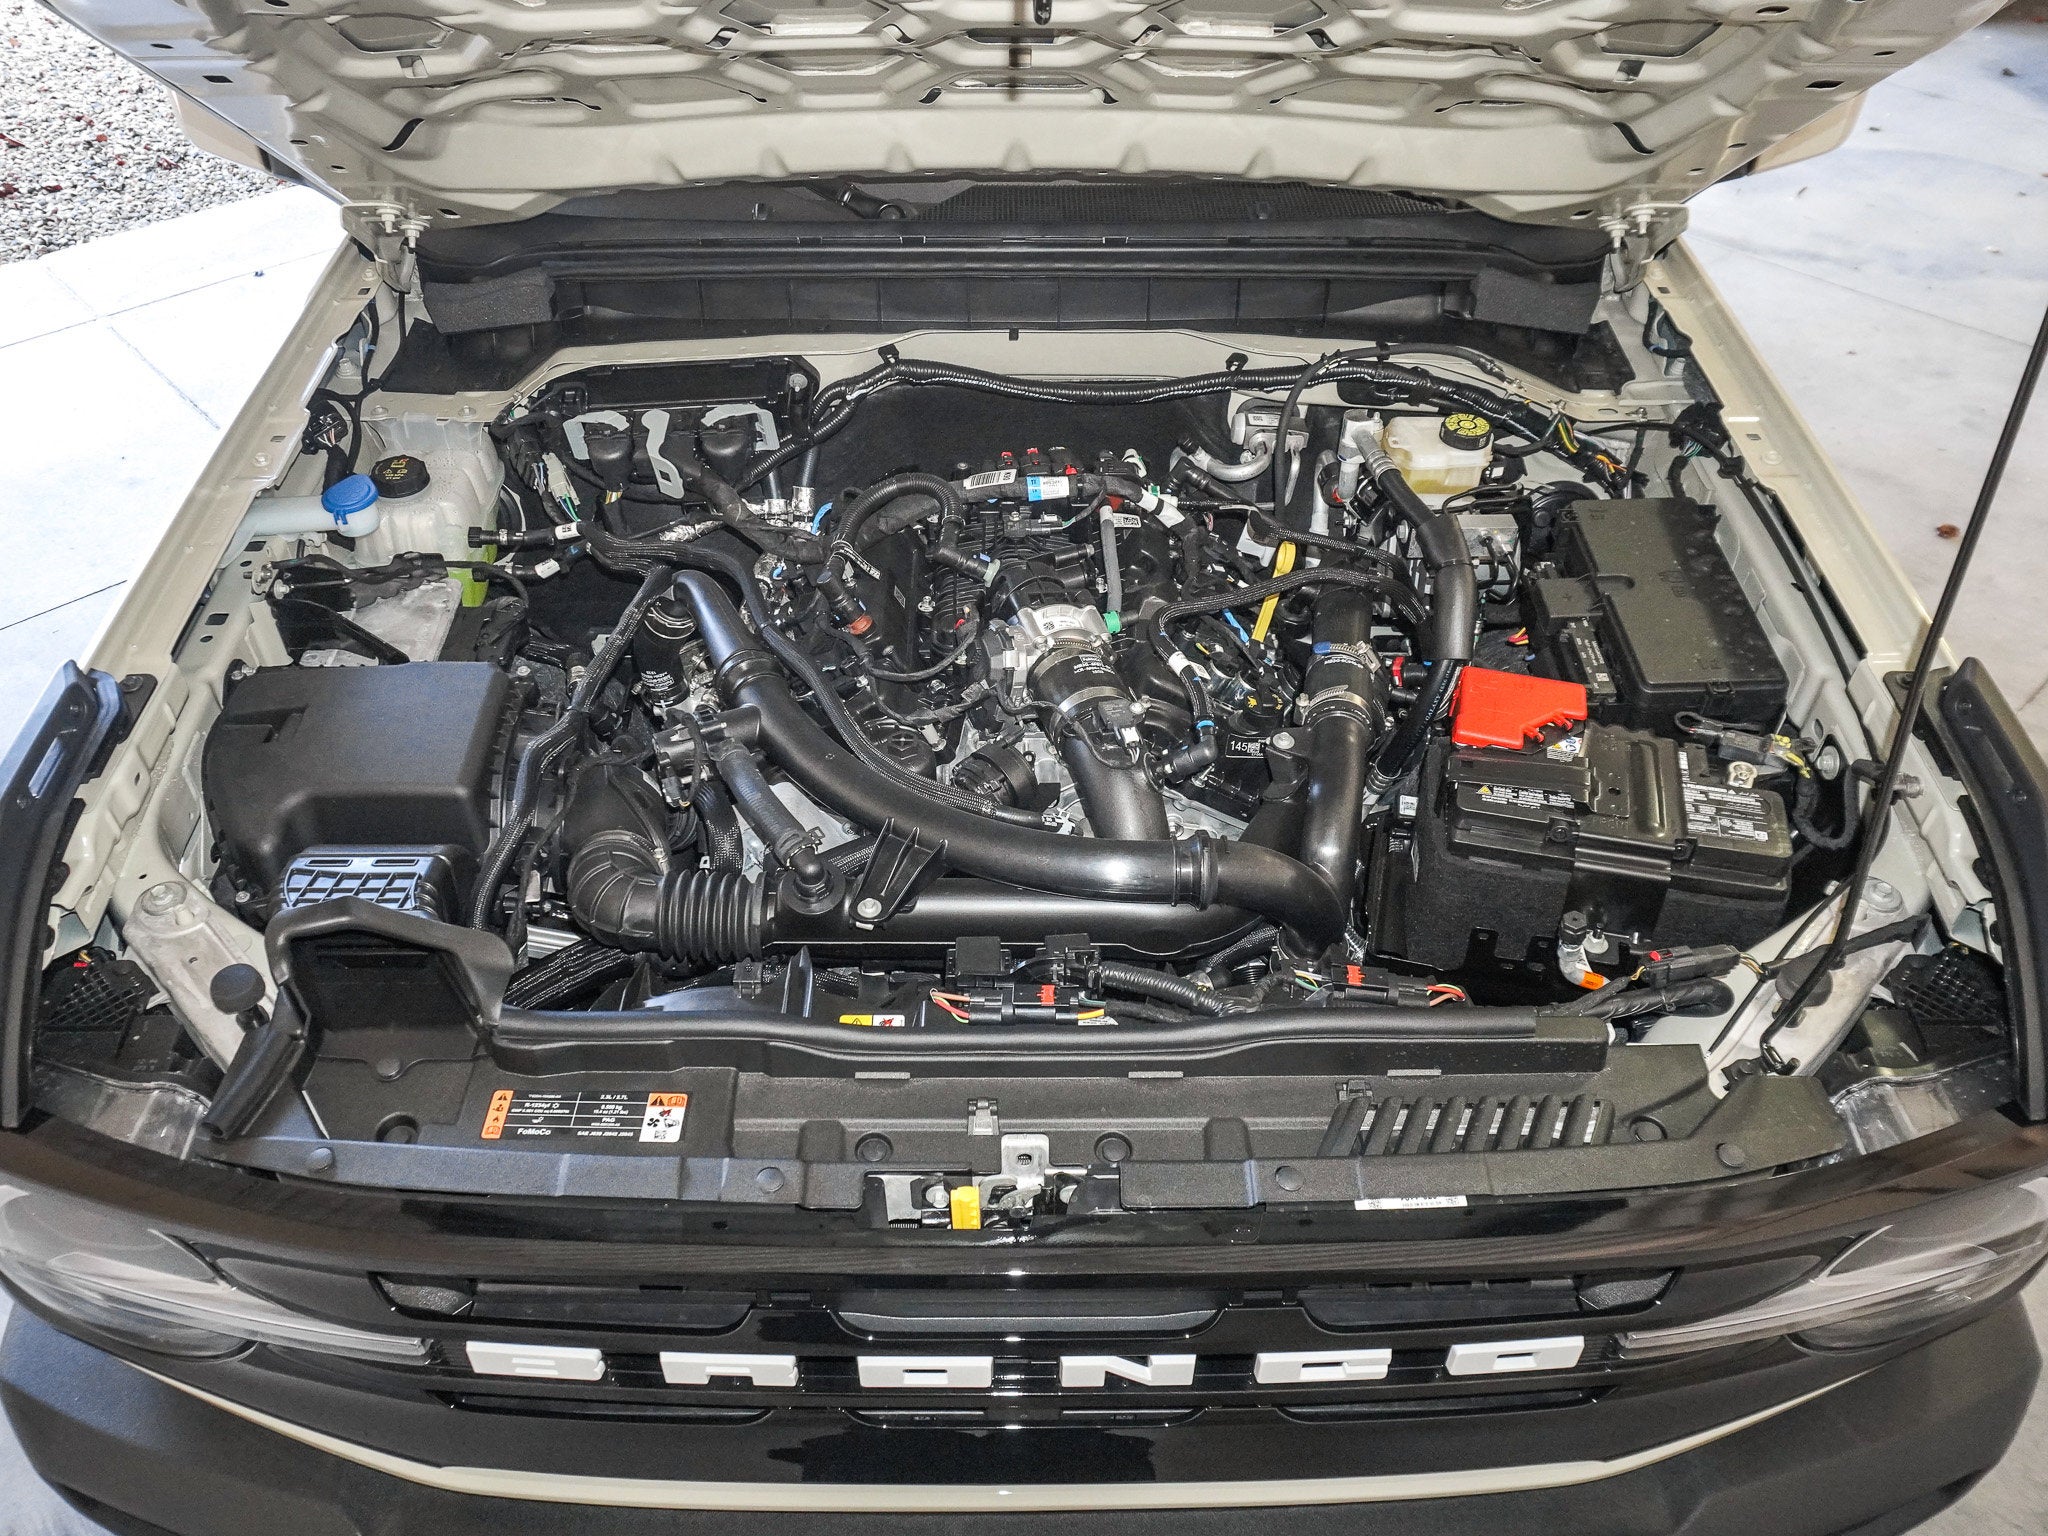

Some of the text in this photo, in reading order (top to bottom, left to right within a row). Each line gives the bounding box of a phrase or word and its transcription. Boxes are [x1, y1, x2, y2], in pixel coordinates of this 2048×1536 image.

[1425, 695, 1441, 721] GALAXY
[1230, 740, 1248, 751] 145
[466, 1336, 1585, 1387] BRONCO
